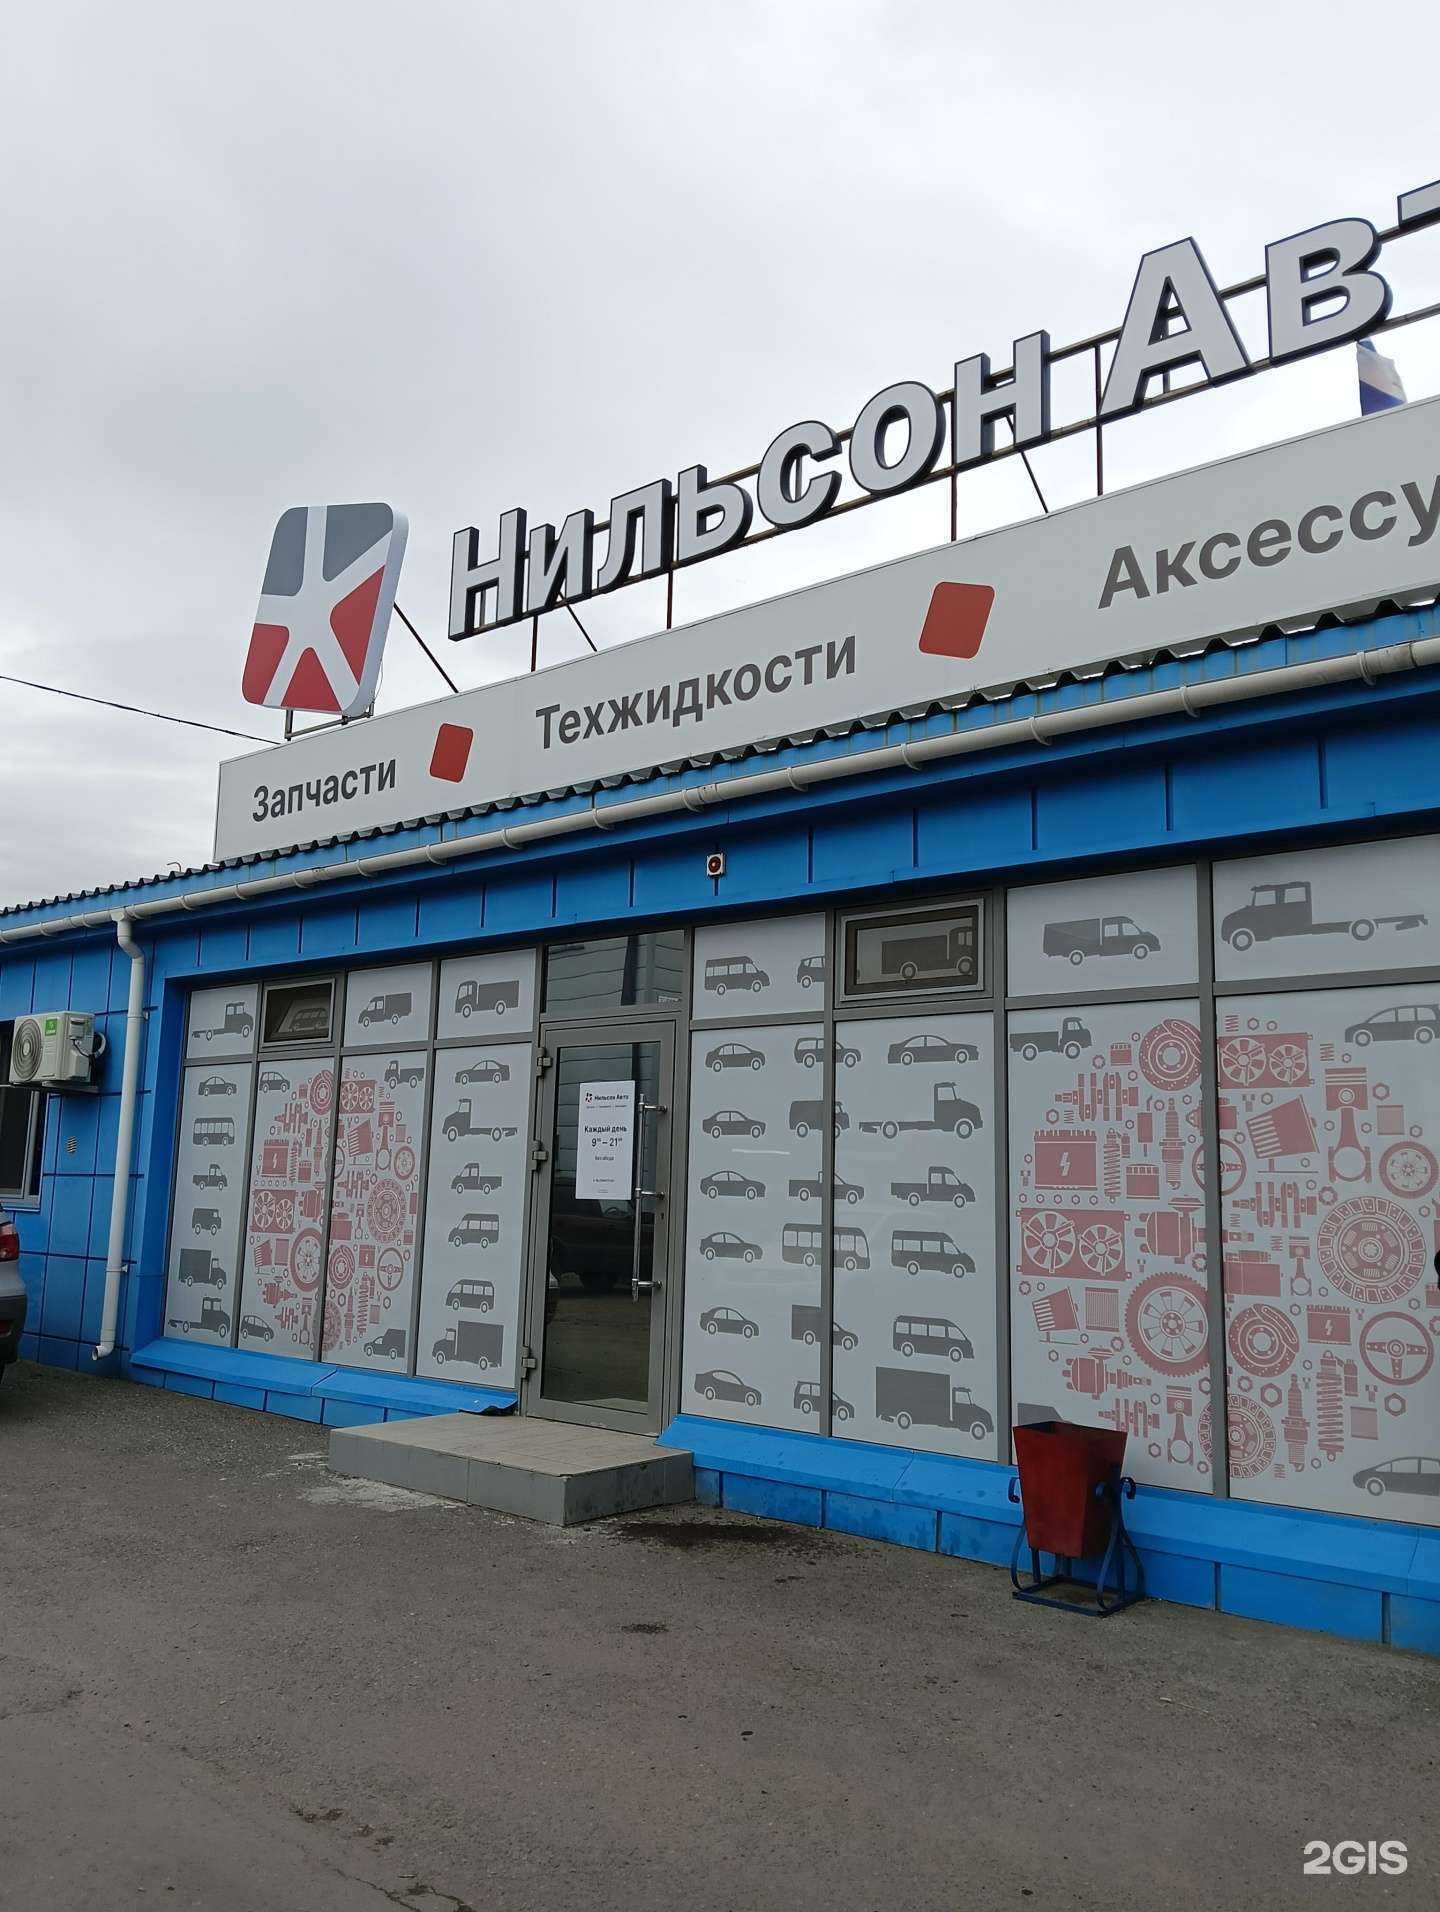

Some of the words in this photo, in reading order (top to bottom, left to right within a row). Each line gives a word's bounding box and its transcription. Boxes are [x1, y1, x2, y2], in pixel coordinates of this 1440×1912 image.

[448, 329, 1050, 642] Нильсон
[252, 758, 397, 822] Запчасти
[535, 635, 857, 749] Техжидкости
[1097, 474, 1440, 609] Аксессу
[584, 1125, 611, 1134] Каждый
[611, 1125, 627, 1133] день
